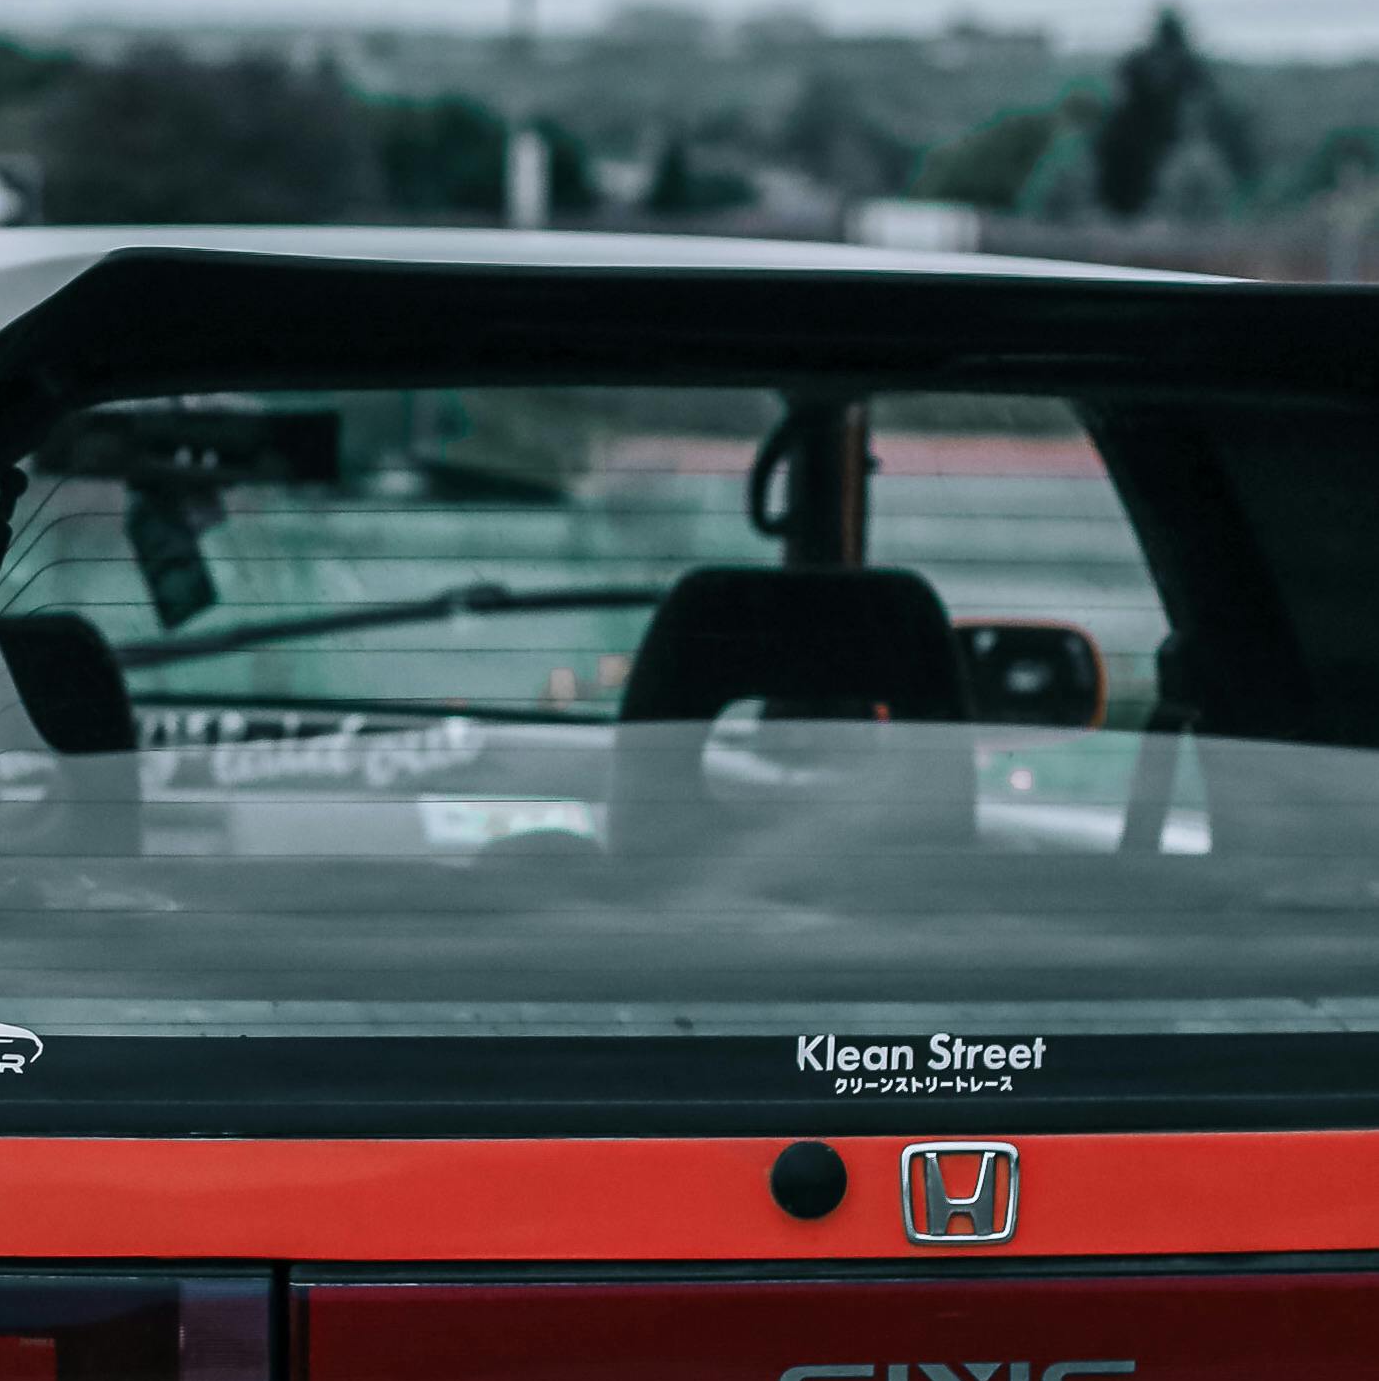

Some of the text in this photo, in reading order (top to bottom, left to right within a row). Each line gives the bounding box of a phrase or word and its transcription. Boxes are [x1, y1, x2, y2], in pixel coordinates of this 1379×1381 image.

[797, 1032, 1047, 1072] Klean Street
[834, 1075, 1013, 1095] クリーンストリートレース
